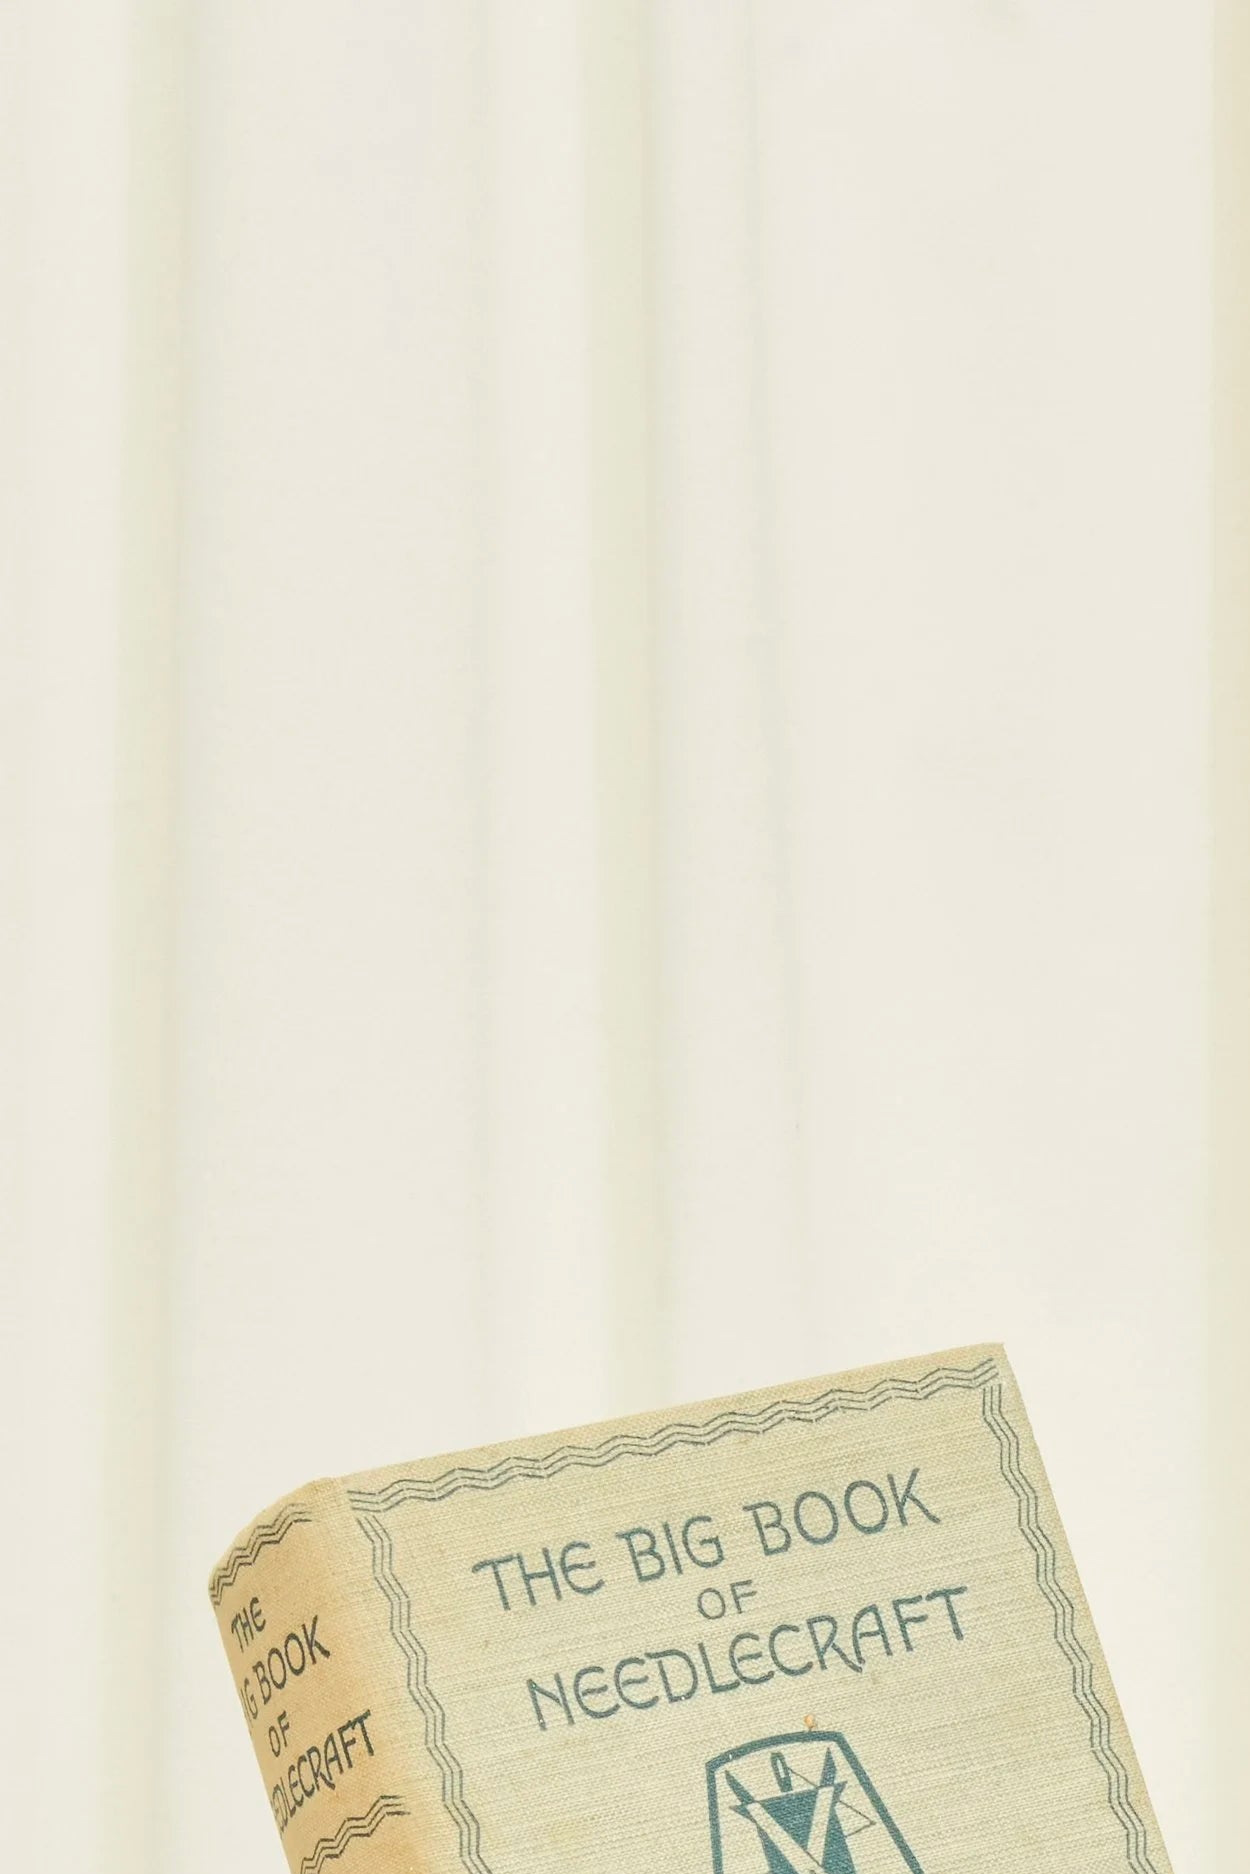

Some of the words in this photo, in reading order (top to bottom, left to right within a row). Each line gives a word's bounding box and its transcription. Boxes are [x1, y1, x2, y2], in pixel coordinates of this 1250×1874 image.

[471, 1541, 606, 1612] THE
[614, 1514, 726, 1584] BIG
[741, 1467, 942, 1557] BOOK
[230, 1596, 267, 1654] THE
[696, 1579, 758, 1621] OF
[238, 1676, 259, 1731] IG
[252, 1614, 332, 1706] BOOK
[525, 1585, 968, 1732] NEEDLECRAFT
[267, 1709, 290, 1758] OF
